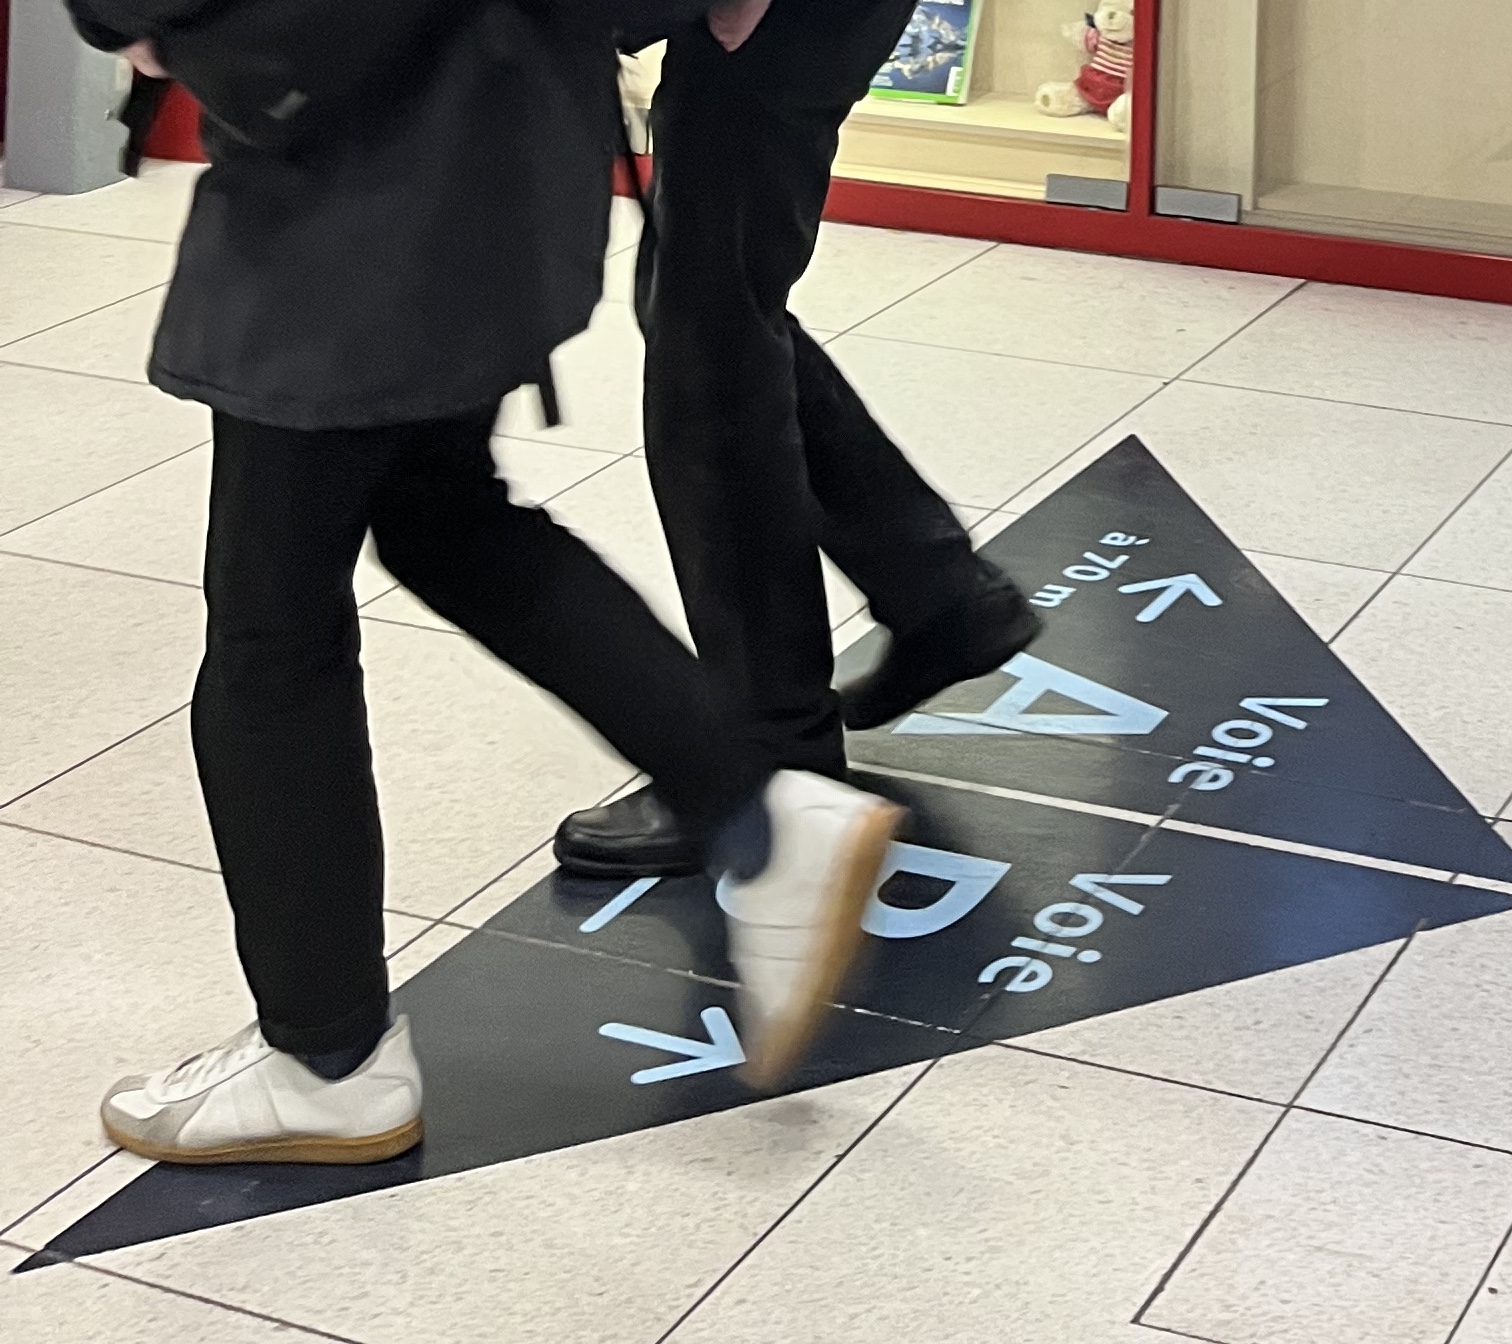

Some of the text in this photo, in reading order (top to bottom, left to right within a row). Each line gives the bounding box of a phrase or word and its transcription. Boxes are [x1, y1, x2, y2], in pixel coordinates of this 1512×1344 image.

[1028, 583, 1078, 608] m
[1061, 550, 1131, 582] 70
[891, 650, 1171, 738] A
[1165, 693, 1333, 794] Voie
[976, 871, 1174, 994] Voie
